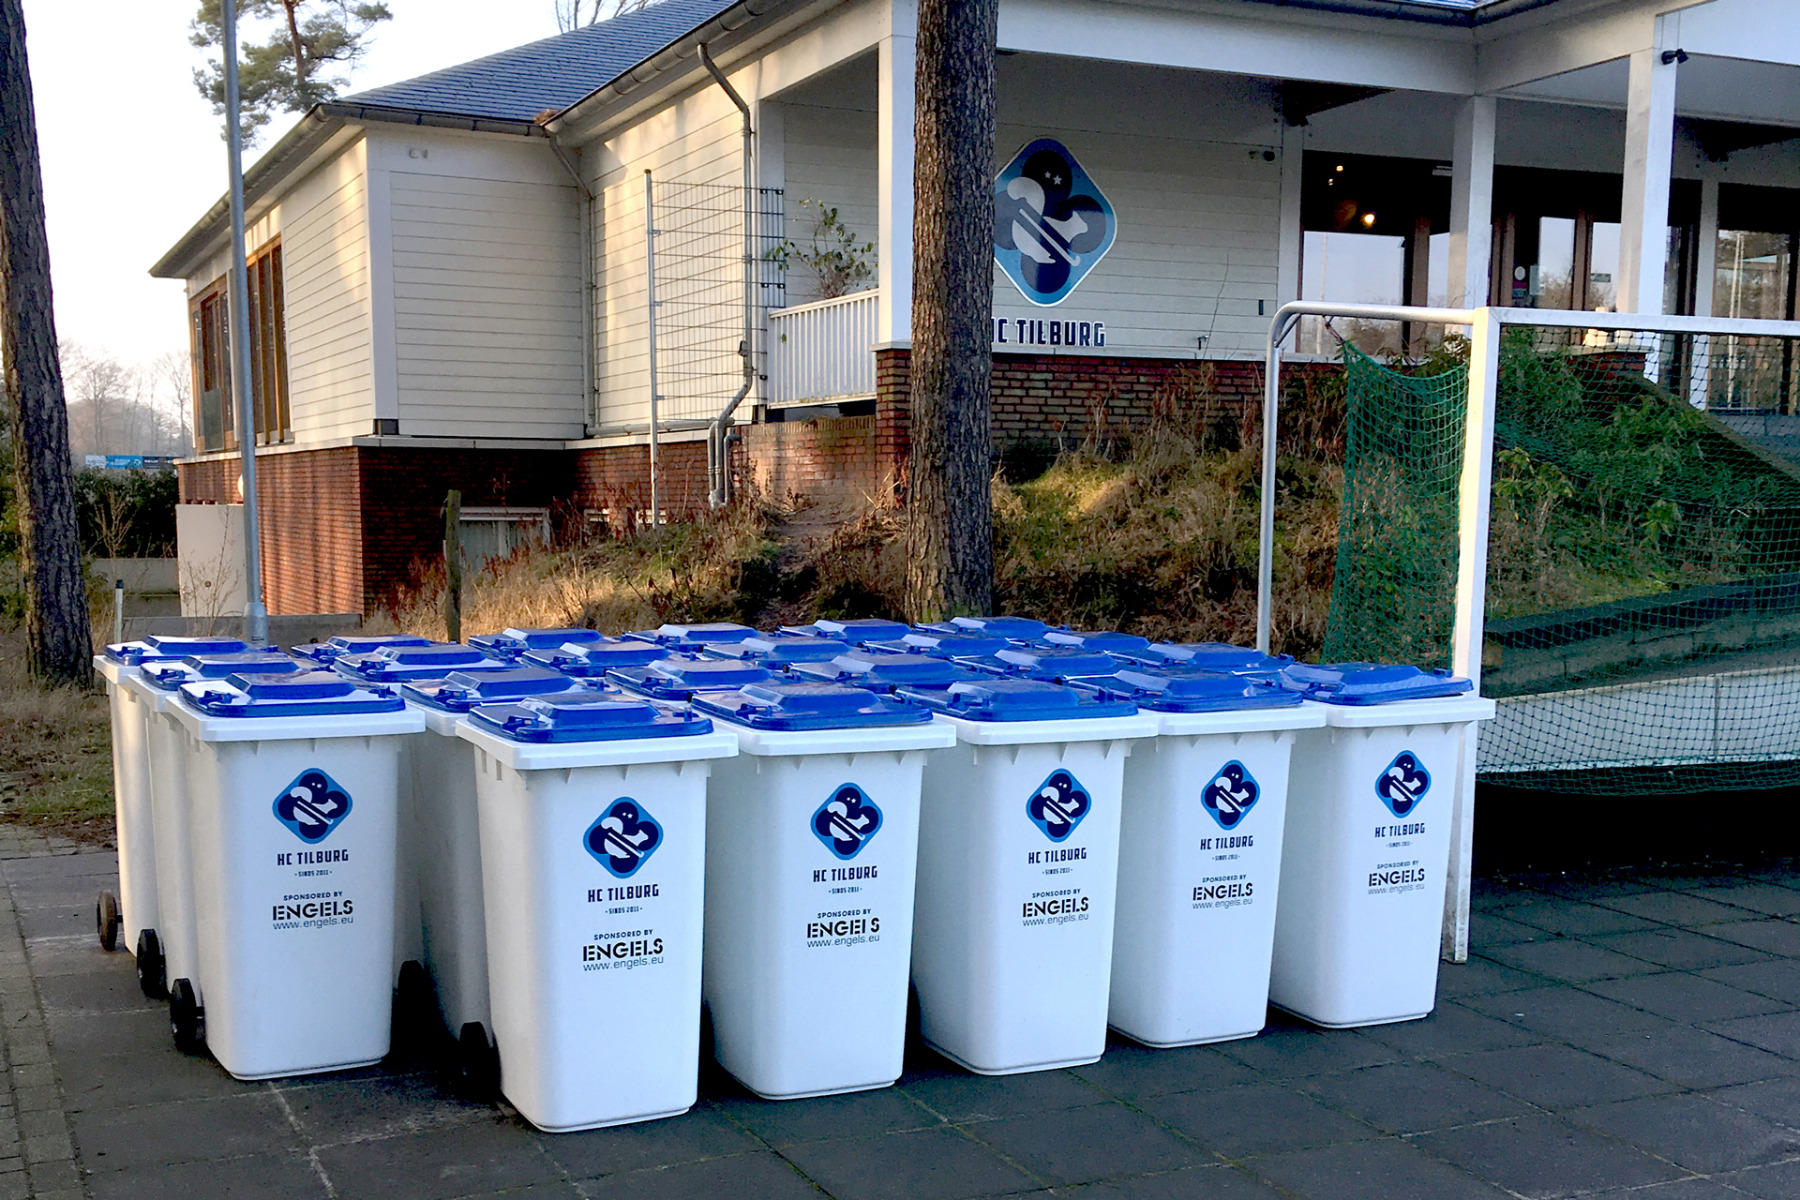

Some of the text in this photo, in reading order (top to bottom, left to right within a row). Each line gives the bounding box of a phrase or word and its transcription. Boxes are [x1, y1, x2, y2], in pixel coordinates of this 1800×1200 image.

[1016, 319, 1105, 347] TILBURG
[1375, 822, 1425, 838] HC TILBURG
[1200, 835, 1254, 850] HC TILBURG
[277, 849, 349, 866] HC TILBURG
[1028, 847, 1087, 864] HC TILBURG
[813, 865, 878, 882] HC TILBURG
[1202, 875, 1238, 883] SPONSORED
[1369, 868, 1425, 887] ENGELS
[283, 892, 331, 901] SPONSORED
[588, 884, 659, 902] HC TILBURG
[1032, 889, 1071, 898] SPONSORED
[1193, 882, 1253, 901] ENGELS
[272, 899, 353, 921] ENGELS
[626, 905, 640, 913] 2011
[1022, 896, 1089, 917] ENGELS
[1192, 899, 1253, 909] www.engels.eu
[817, 909, 861, 919] SPONSORED
[1022, 913, 1089, 926] www.engels.eu
[272, 917, 354, 930] www.engels.eu
[594, 930, 642, 940] SPONSORED
[806, 935, 880, 948] www.engels.eu
[583, 938, 664, 961] ENGELS
[583, 957, 664, 971] www.engels.eu
